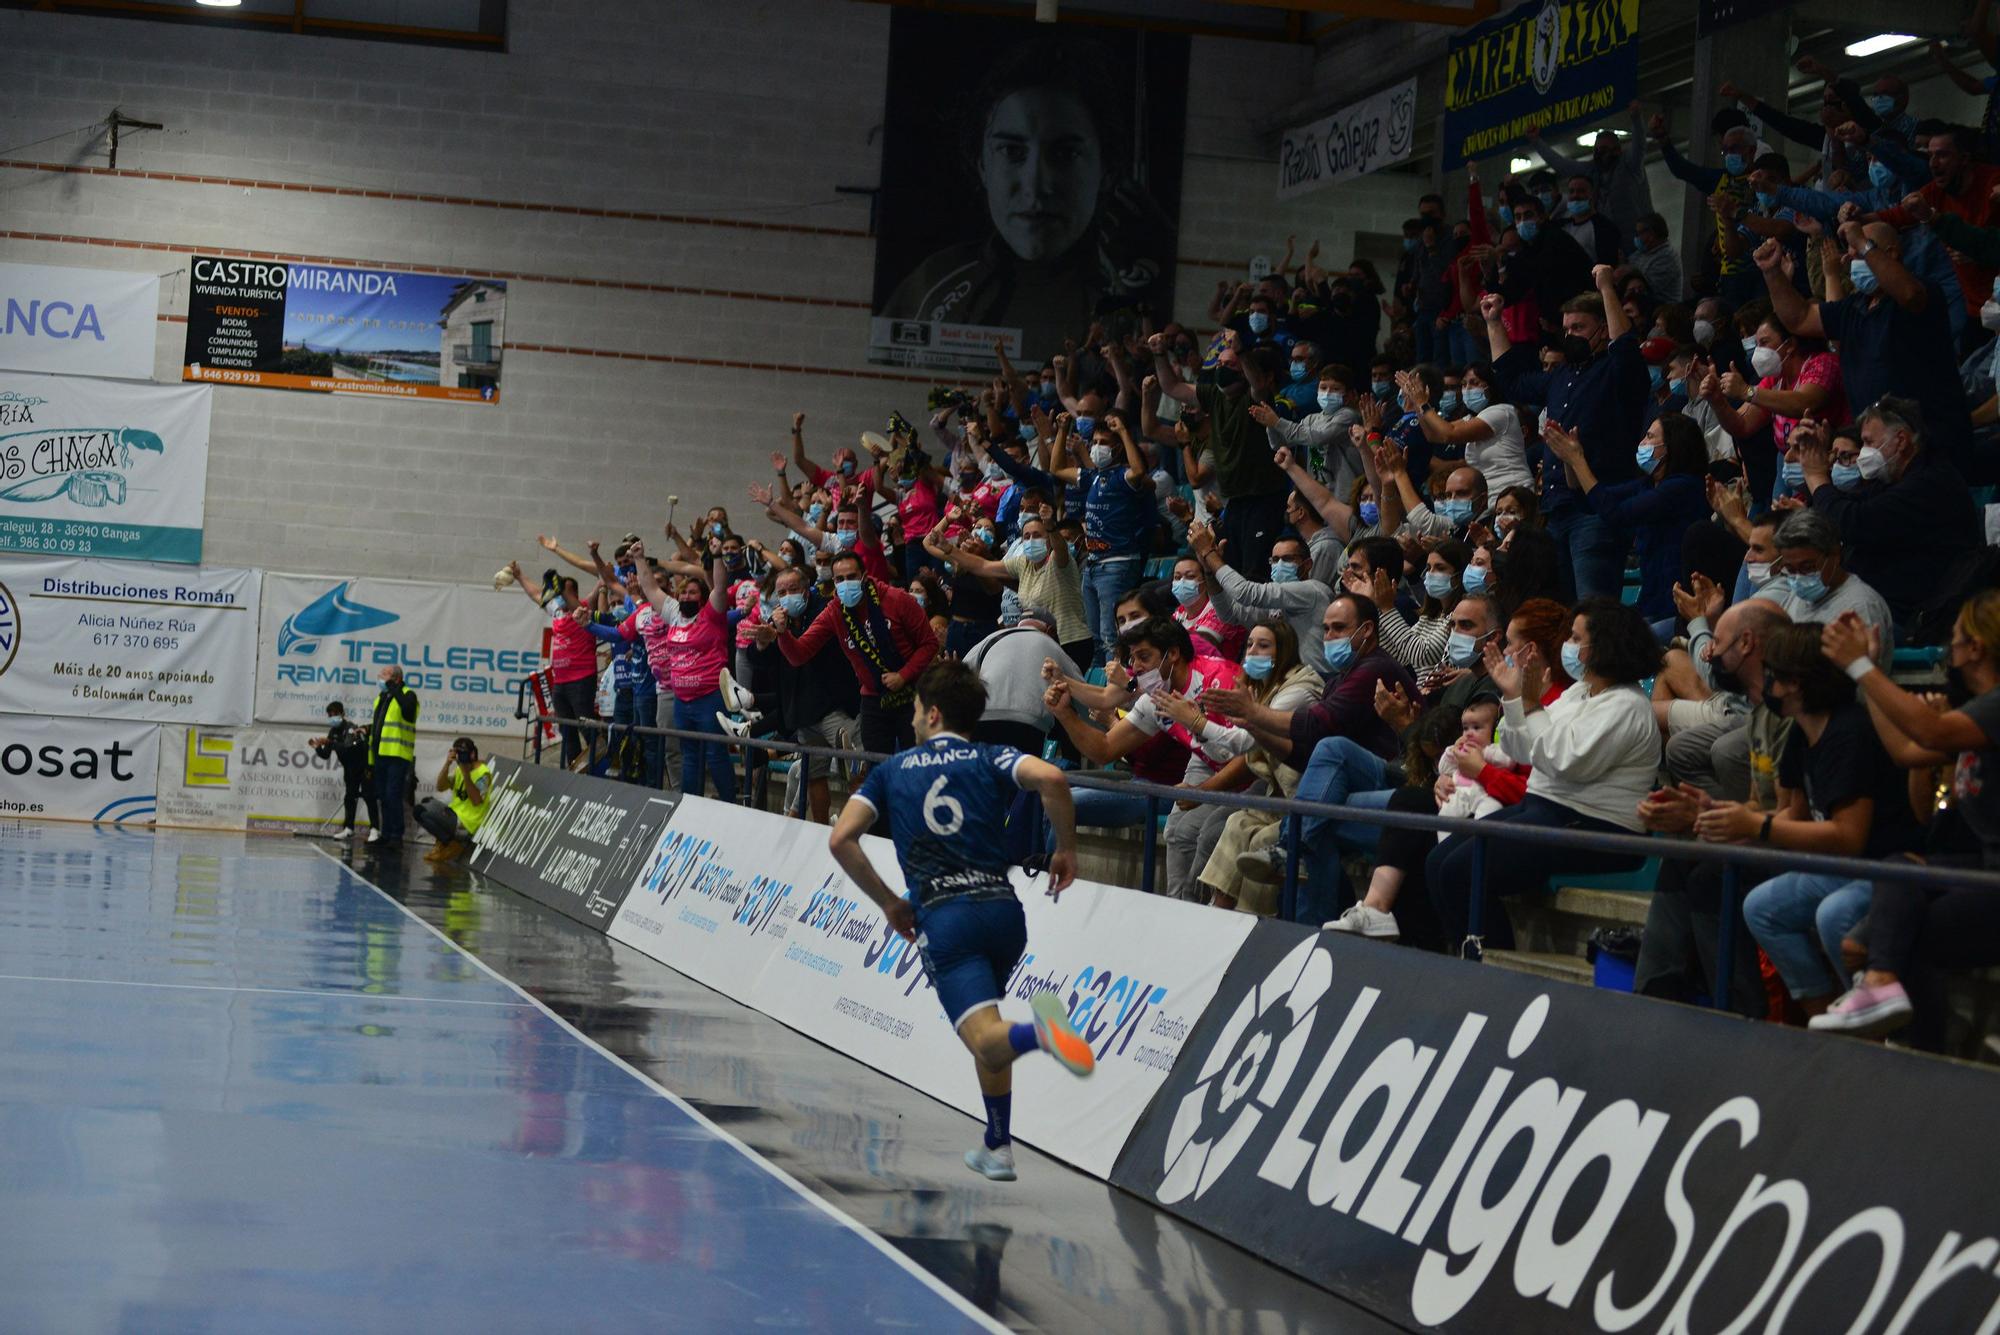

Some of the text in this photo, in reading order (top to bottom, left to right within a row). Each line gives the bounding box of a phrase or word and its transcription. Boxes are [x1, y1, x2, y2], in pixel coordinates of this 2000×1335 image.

[195, 284, 283, 300] VIVIENDA TURÍSTICA
[0, 298, 105, 341] NCA
[215, 305, 260, 317] EVENTOS
[216, 327, 252, 337] BAUTIZOS
[222, 318, 248, 327] BODAS
[207, 346, 258, 358] CUMPLEAÑOS
[208, 337, 258, 348] COMUNIONES
[211, 357, 253, 367] REUNIONES
[204, 371, 261, 383] 646 929 923
[310, 378, 417, 395] www.castromiranda.es
[41, 522, 54, 534] 28
[64, 524, 99, 537] 36940
[101, 526, 141, 543] Cangas
[19, 536, 40, 548] 986
[42, 538, 57, 550] 30
[60, 539, 75, 551] 09
[78, 540, 92, 552] 23
[43, 578, 235, 604] Distribuciones Román
[78, 613, 196, 633] Alicia Núñez Rúa
[93, 633, 179, 650] 617 370 695
[53, 662, 215, 685] Máis de 20 anos apoiando
[72, 684, 193, 707] ó Balonmán Cangas
[438, 713, 458, 724] 986
[462, 714, 482, 726] 324
[486, 716, 507, 727] 560
[1, 741, 134, 781] osat
[241, 746, 268, 766] LA
[903, 748, 978, 769] ABANCA
[238, 785, 290, 798] SEGUROS
[923, 774, 964, 836] 6
[640, 830, 712, 906] sacyr
[732, 874, 793, 936] sacyr
[810, 892, 880, 945] sacyr asobal
[1150, 1010, 1188, 1041] Desafíos
[1257, 987, 2000, 1335] LaLigaSpor
